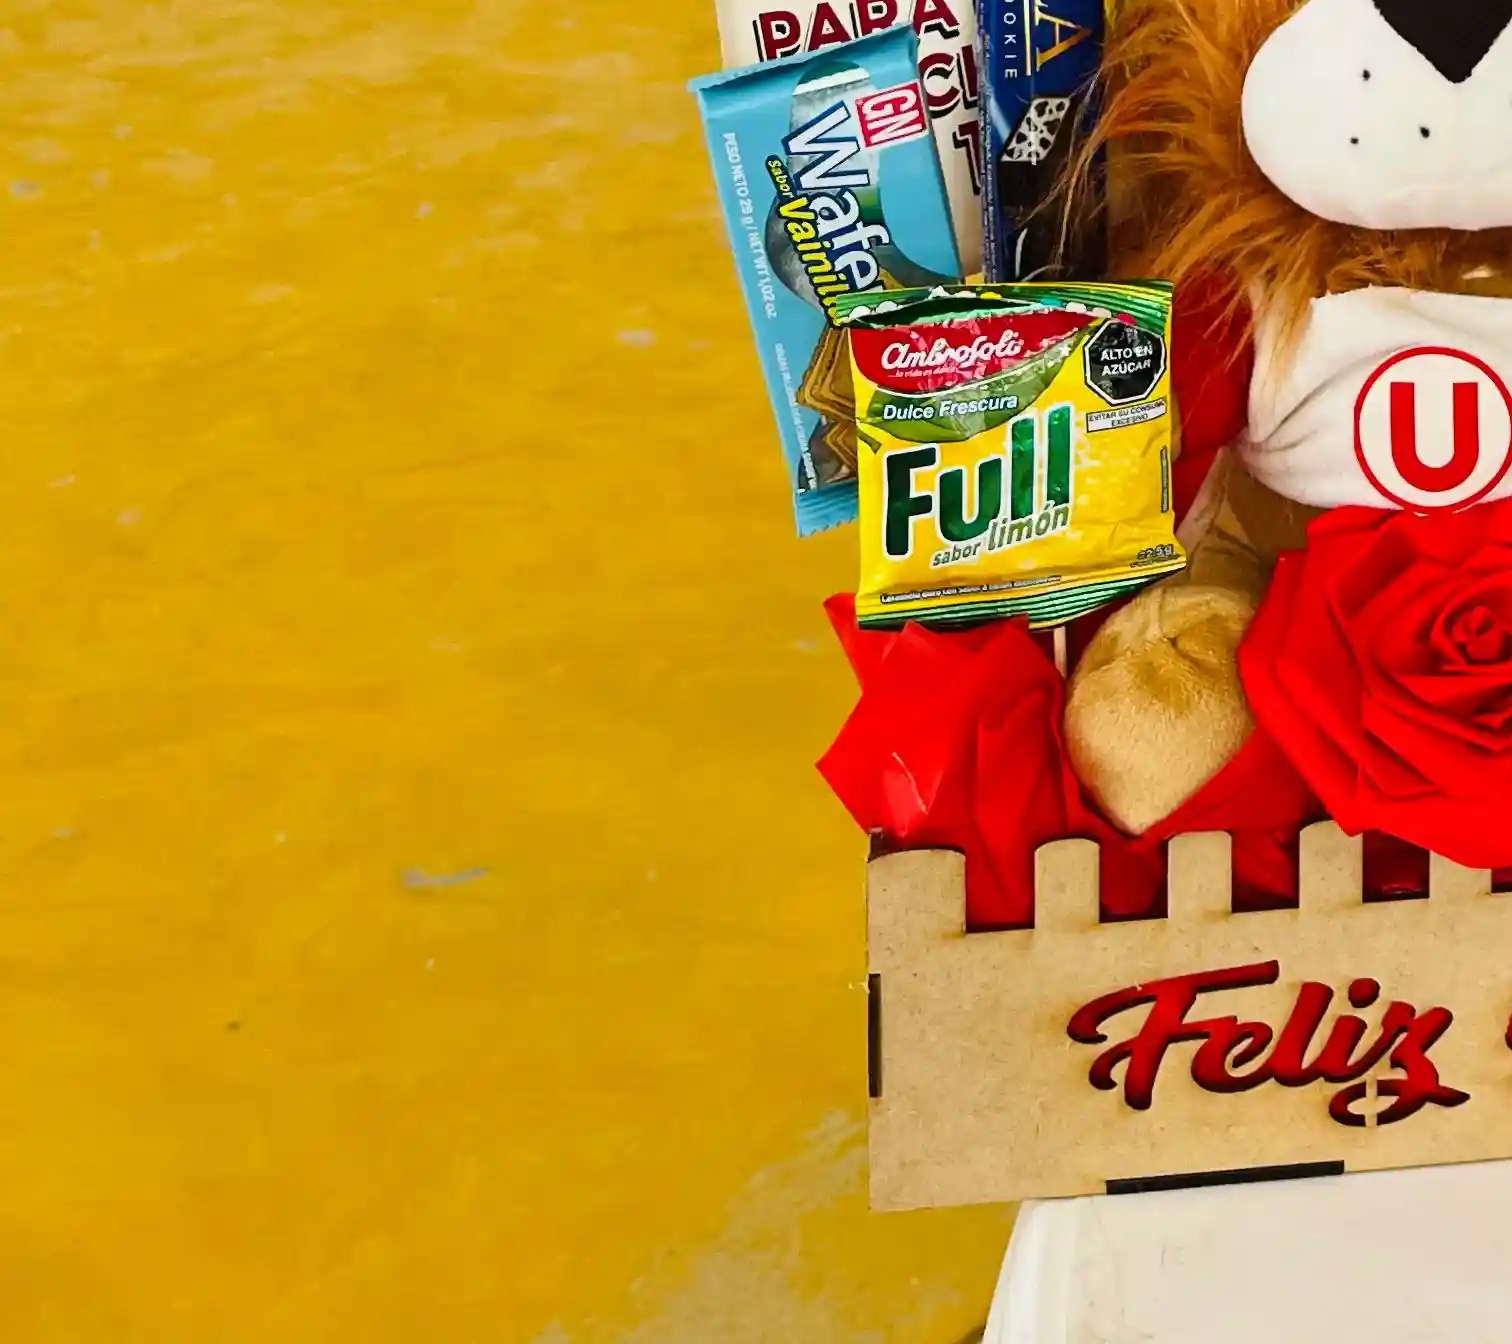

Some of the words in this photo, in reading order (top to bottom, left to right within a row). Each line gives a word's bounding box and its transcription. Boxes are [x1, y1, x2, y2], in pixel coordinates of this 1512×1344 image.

[731, 164, 749, 198] NETO
[767, 158, 794, 199] Sabor
[781, 99, 890, 294] Wafe
[1101, 348, 1132, 361] ALTO
[1134, 343, 1153, 357] EN
[1102, 359, 1151, 376] AZÚCAR
[883, 404, 935, 420] Dulce
[939, 395, 1018, 417] Frescura
[1389, 381, 1480, 493] U
[885, 405, 1072, 556] Full
[932, 542, 982, 567] sabor
[987, 498, 1069, 551] limón
[1066, 959, 1471, 1127] Feliz
